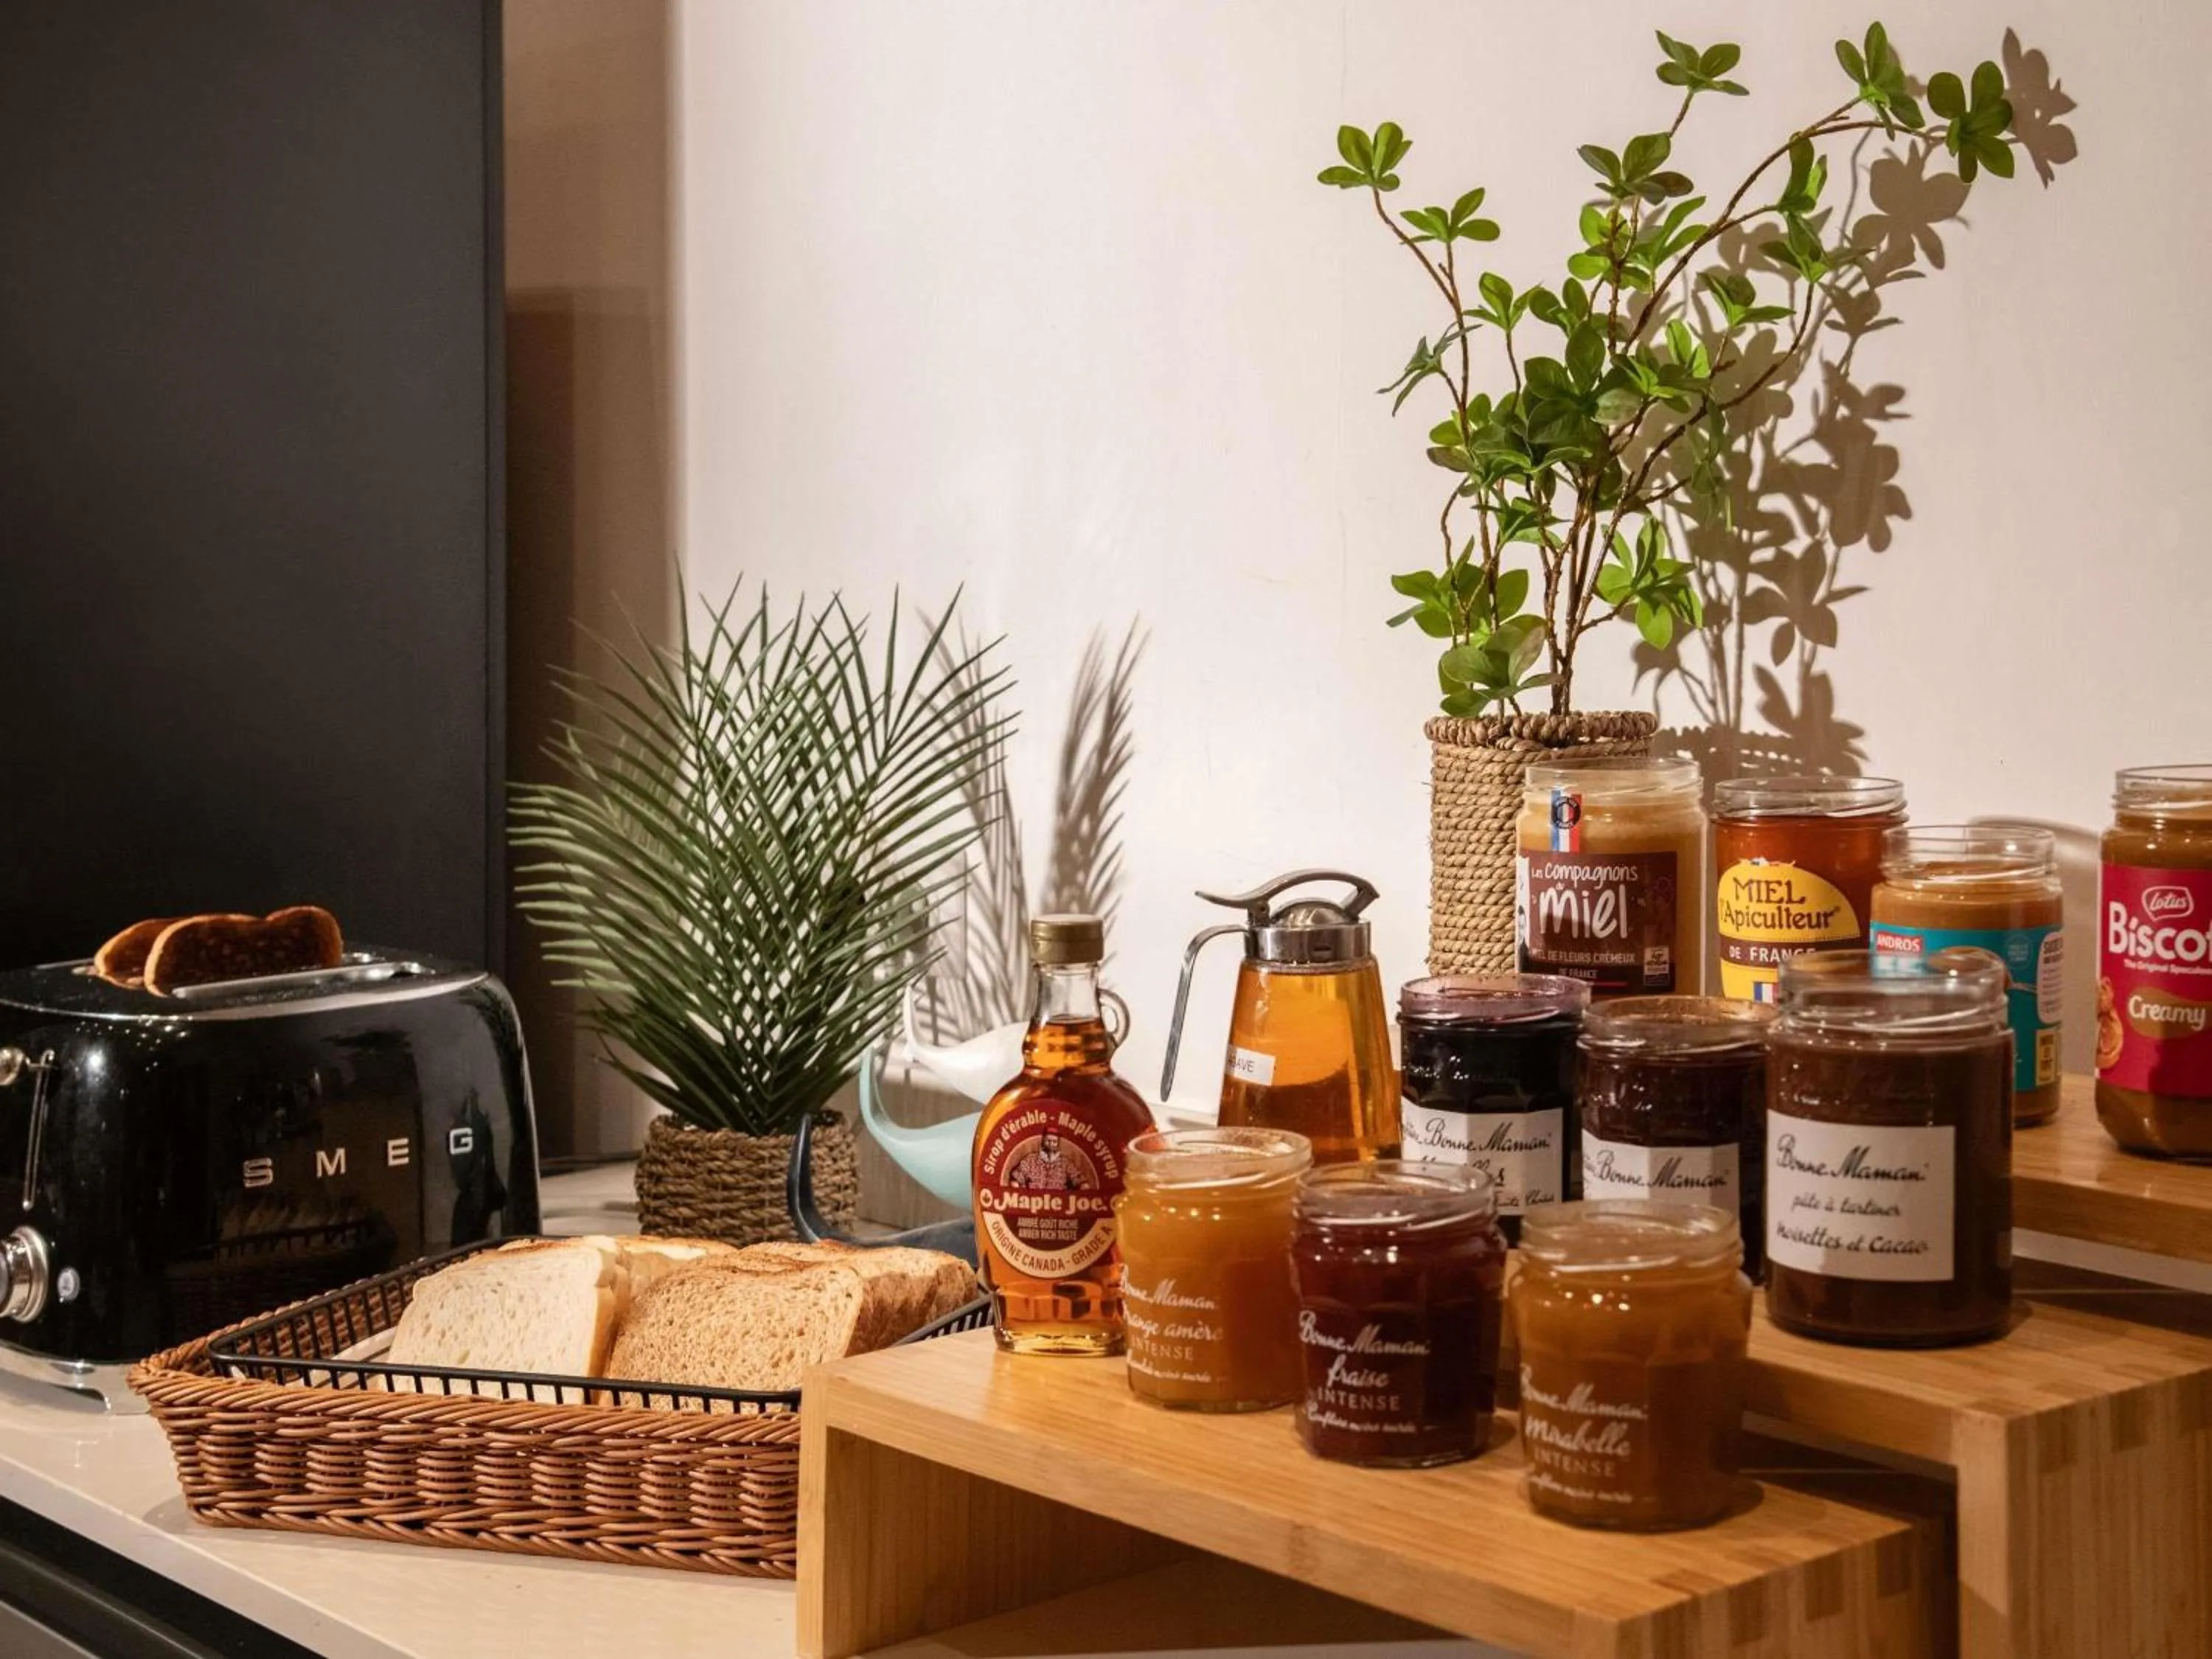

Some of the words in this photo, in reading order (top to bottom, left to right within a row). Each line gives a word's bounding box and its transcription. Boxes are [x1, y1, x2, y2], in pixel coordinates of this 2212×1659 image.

[1545, 862, 1638, 889] Compagnons
[1733, 877, 1806, 905] MIEL
[2149, 892, 2188, 912] Lotus
[1728, 945, 1742, 959] DE
[1877, 933, 1921, 953] ANDROS
[2129, 995, 2206, 1032] Creamy
[984, 1142, 1005, 1175] Sirop
[1057, 1111, 1097, 1142] Maple
[1093, 1135, 1119, 1179] syrup
[1478, 1121, 1550, 1152] Maman
[243, 1127, 473, 1189] SMEG
[1596, 1149, 1644, 1186] Bonne
[1646, 1155, 1726, 1189] Maman
[1776, 1133, 1829, 1177] Bonne
[1831, 1145, 1926, 1181] Maman
[993, 1190, 1062, 1214] Maple
[1065, 1194, 1106, 1215] Joe
[991, 1220, 1023, 1261] ORIGINE
[1021, 1251, 1066, 1273] CANADA
[1071, 1234, 1103, 1265] GRADE
[1101, 1225, 1113, 1237] A
[1318, 1386, 1401, 1411] INTENSE
[1534, 1446, 1617, 1478] INTENSE
